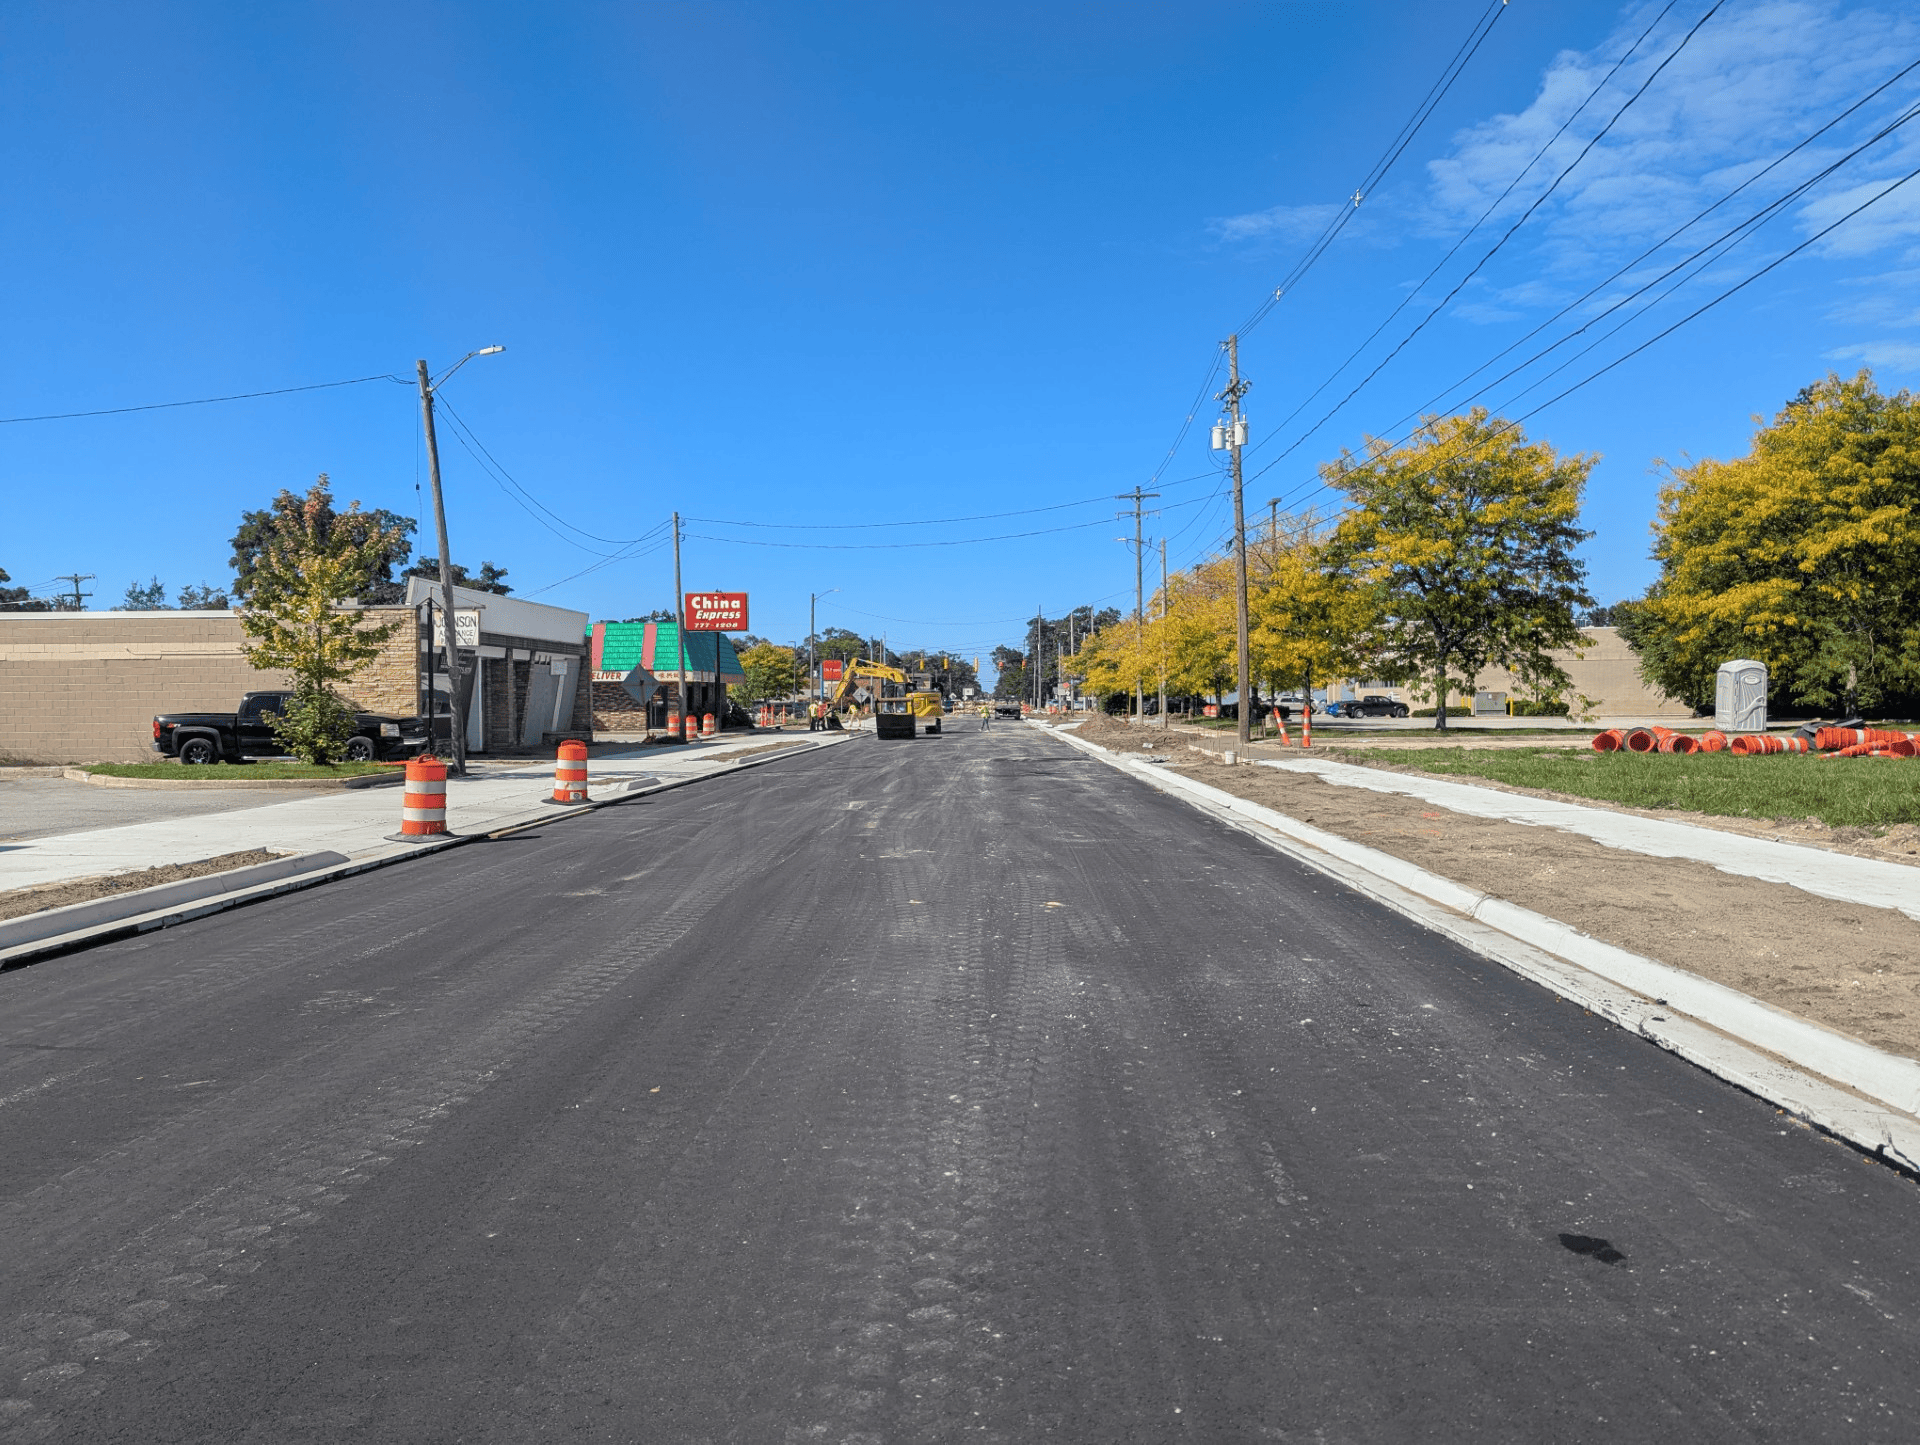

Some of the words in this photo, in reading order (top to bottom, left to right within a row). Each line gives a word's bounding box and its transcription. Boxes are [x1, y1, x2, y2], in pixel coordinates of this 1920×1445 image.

[691, 596, 740, 609] China
[435, 615, 477, 628] JONSON
[695, 610, 741, 621] Express
